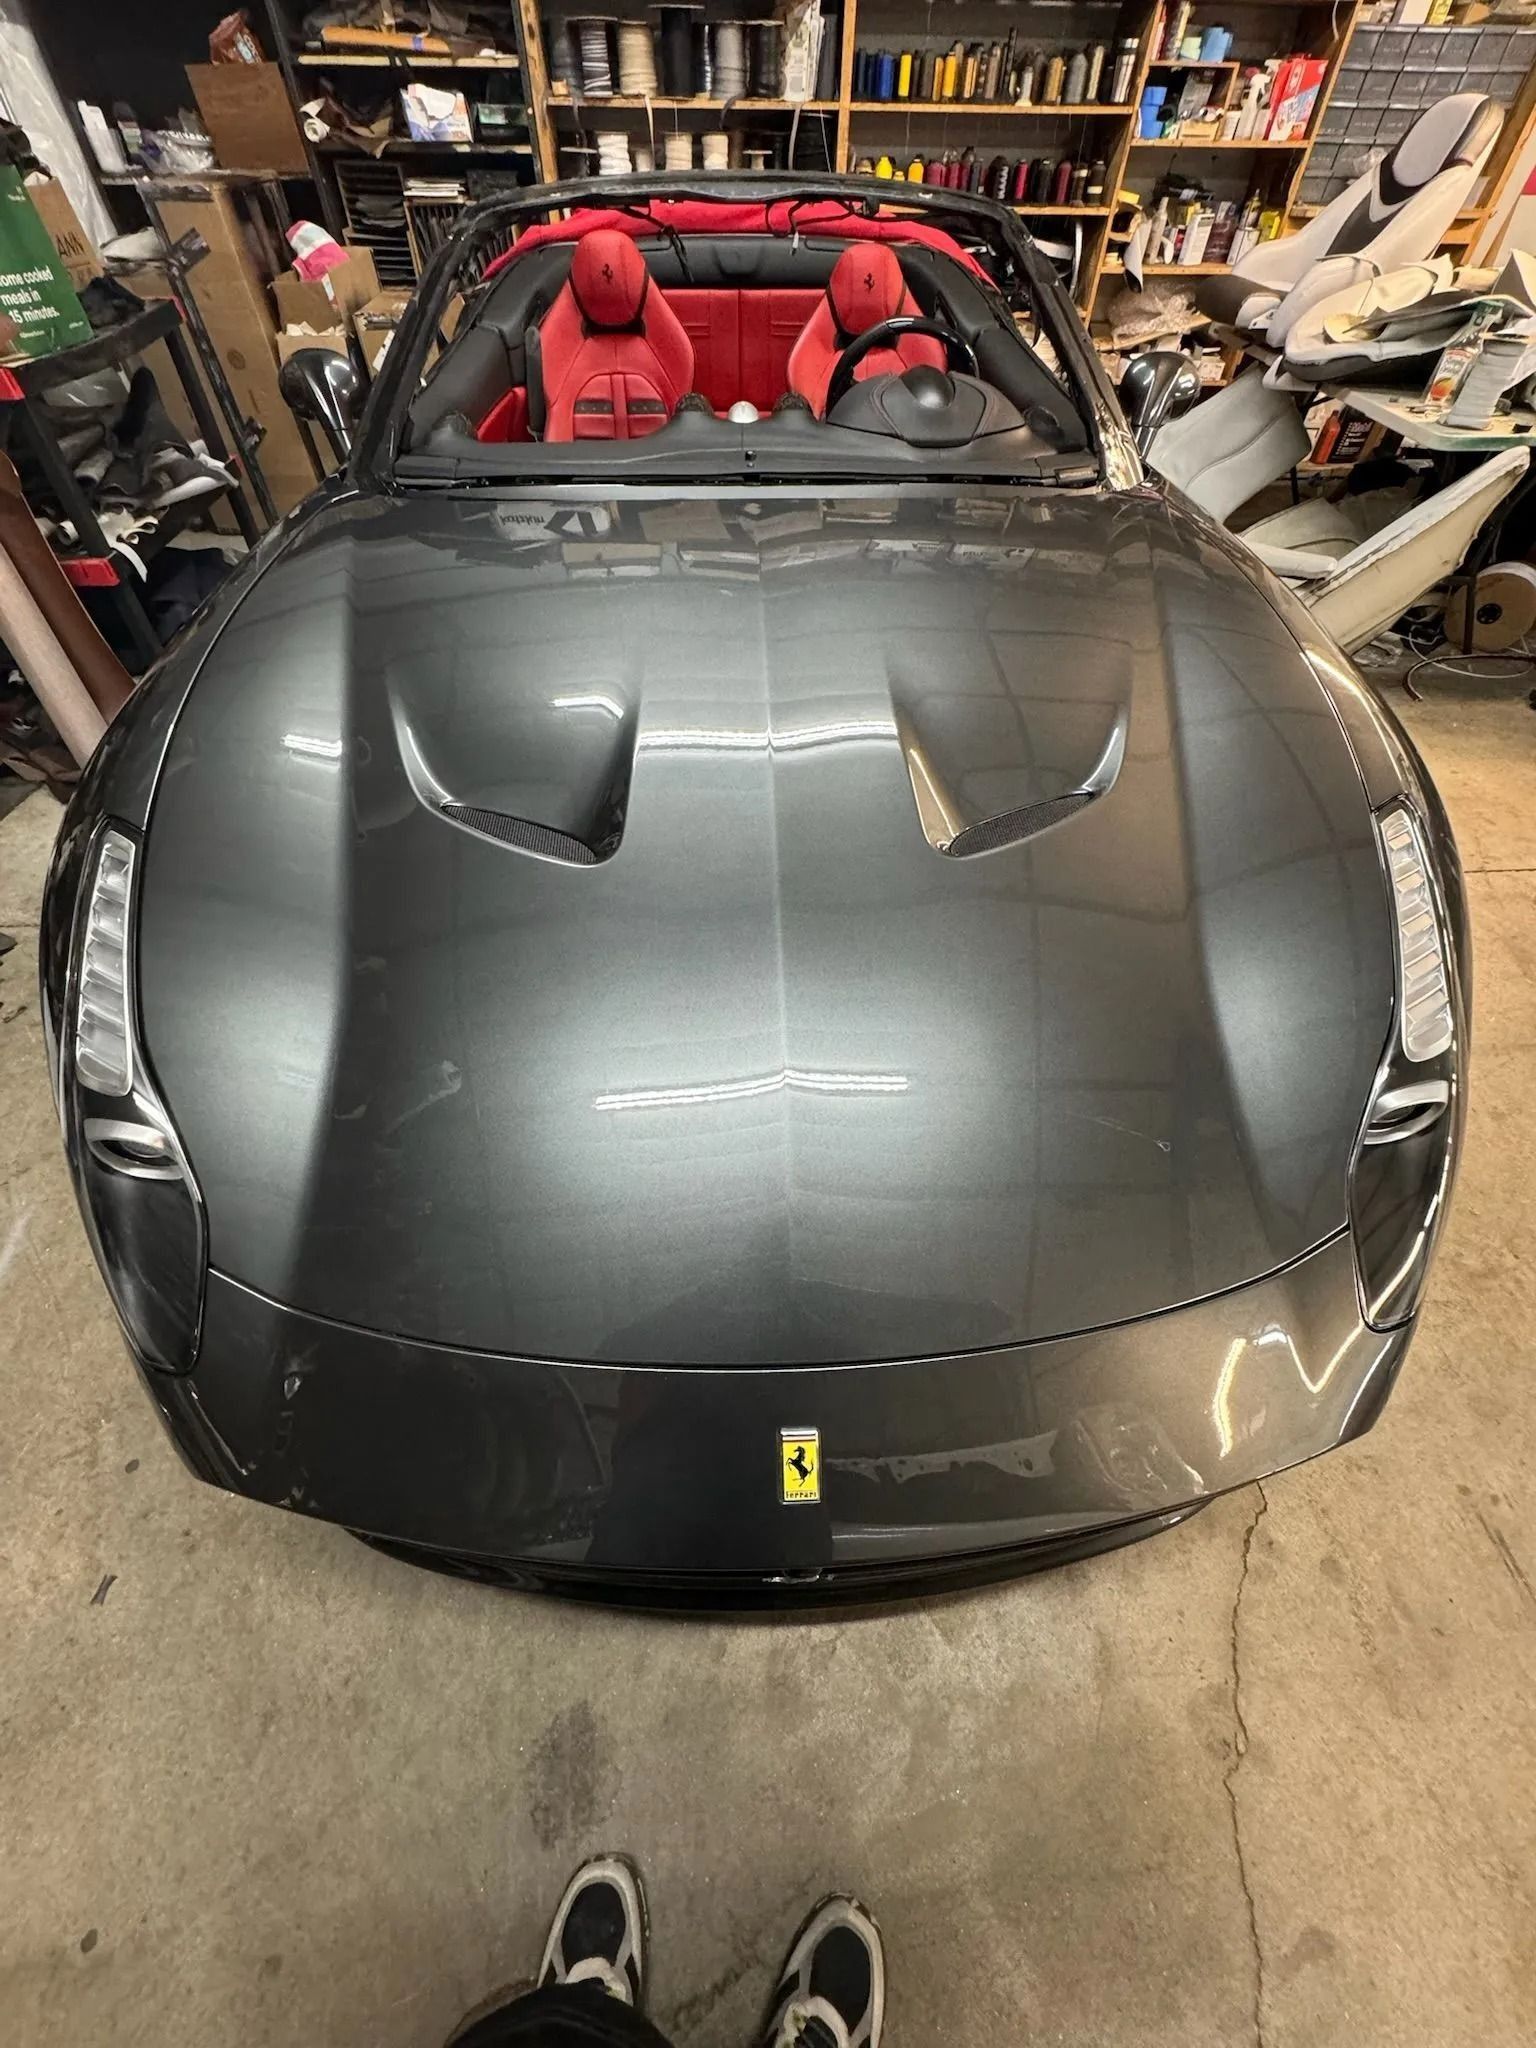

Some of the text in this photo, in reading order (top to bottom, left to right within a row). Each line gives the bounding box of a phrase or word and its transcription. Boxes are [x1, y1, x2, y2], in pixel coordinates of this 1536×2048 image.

[23, 265, 54, 284] cooked
[0, 287, 42, 306] meals in
[8, 305, 60, 323] 15 minutes.
